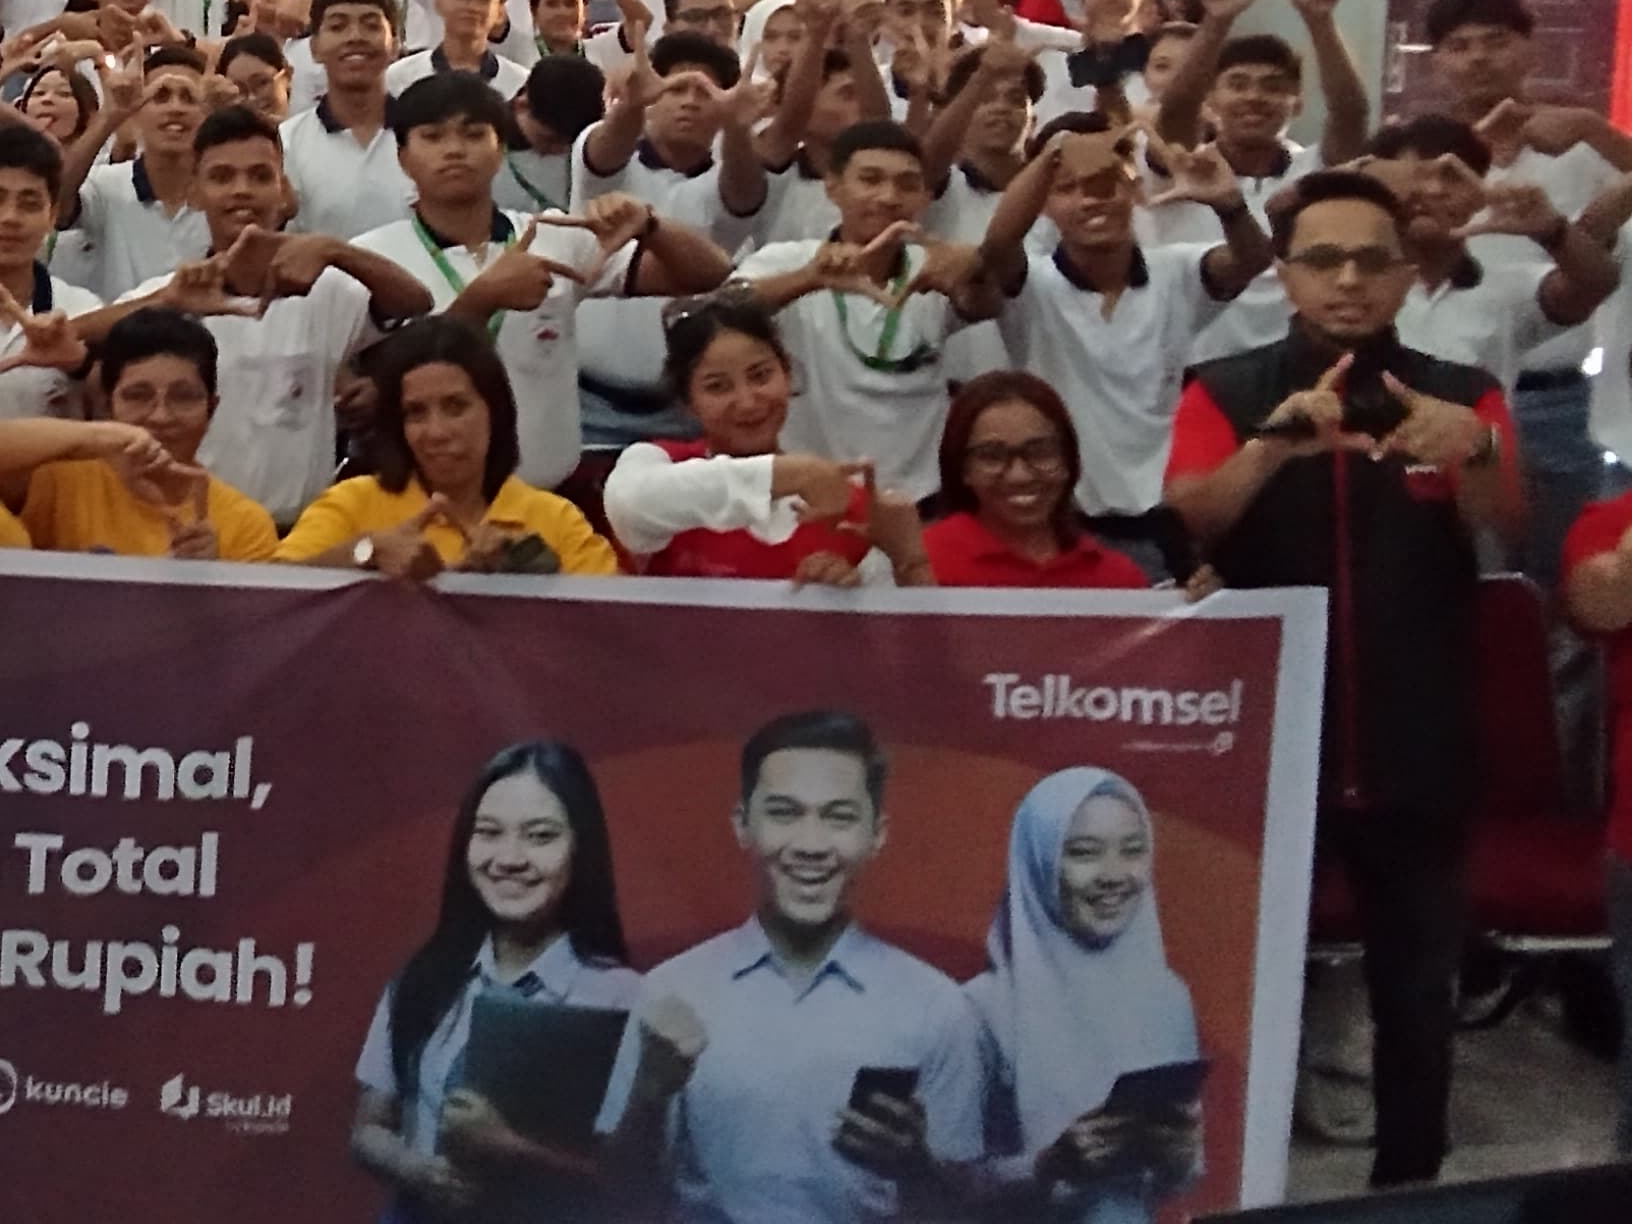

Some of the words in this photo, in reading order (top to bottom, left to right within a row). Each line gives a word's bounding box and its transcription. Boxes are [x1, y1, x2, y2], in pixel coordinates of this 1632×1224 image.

[982, 673, 1244, 725] Telkomsel
[14, 832, 218, 897] Total
[0, 928, 315, 1013] Rupiah!
